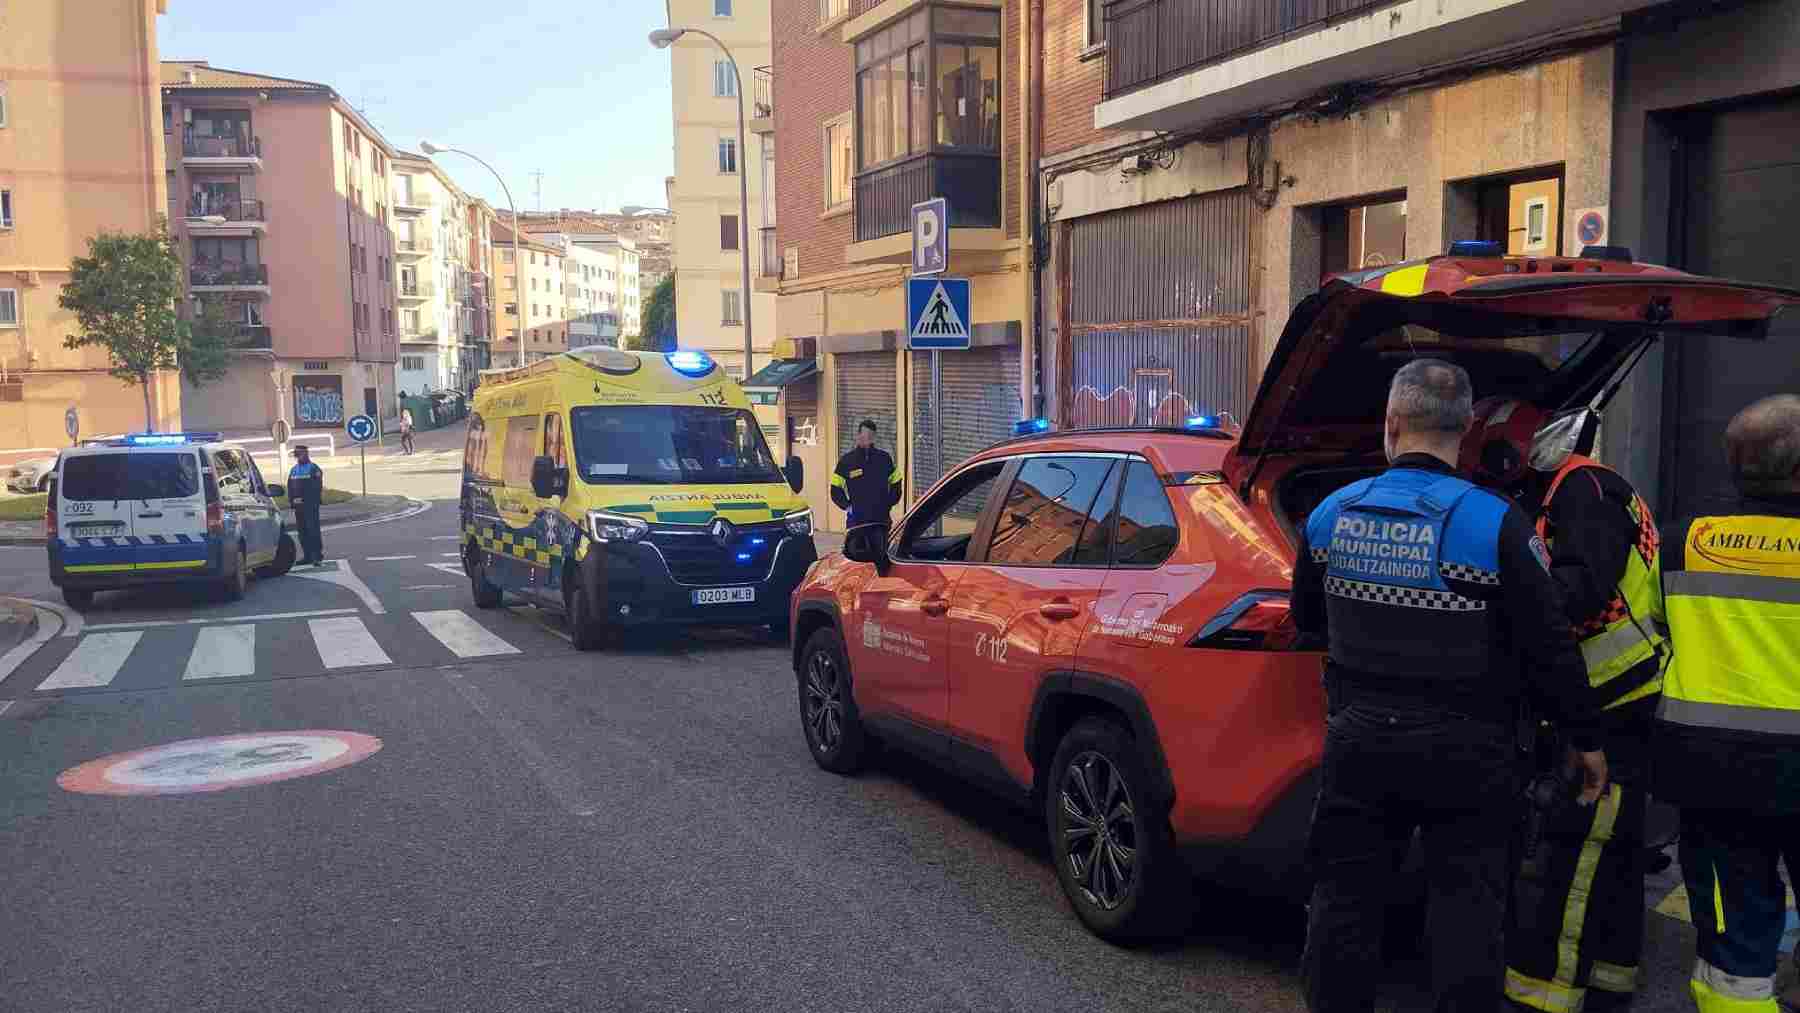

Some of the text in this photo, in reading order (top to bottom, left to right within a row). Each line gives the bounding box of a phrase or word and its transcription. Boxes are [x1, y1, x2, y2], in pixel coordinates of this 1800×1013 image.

[918, 209, 938, 267] P
[699, 387, 728, 405] 112
[72, 502, 94, 512] 092
[1334, 516, 1434, 545] POLICIA
[1331, 538, 1432, 562] MUNICIPAL
[1705, 533, 1800, 552] AMBULAN
[700, 590, 729, 602] 0203
[990, 634, 1009, 663] 112
